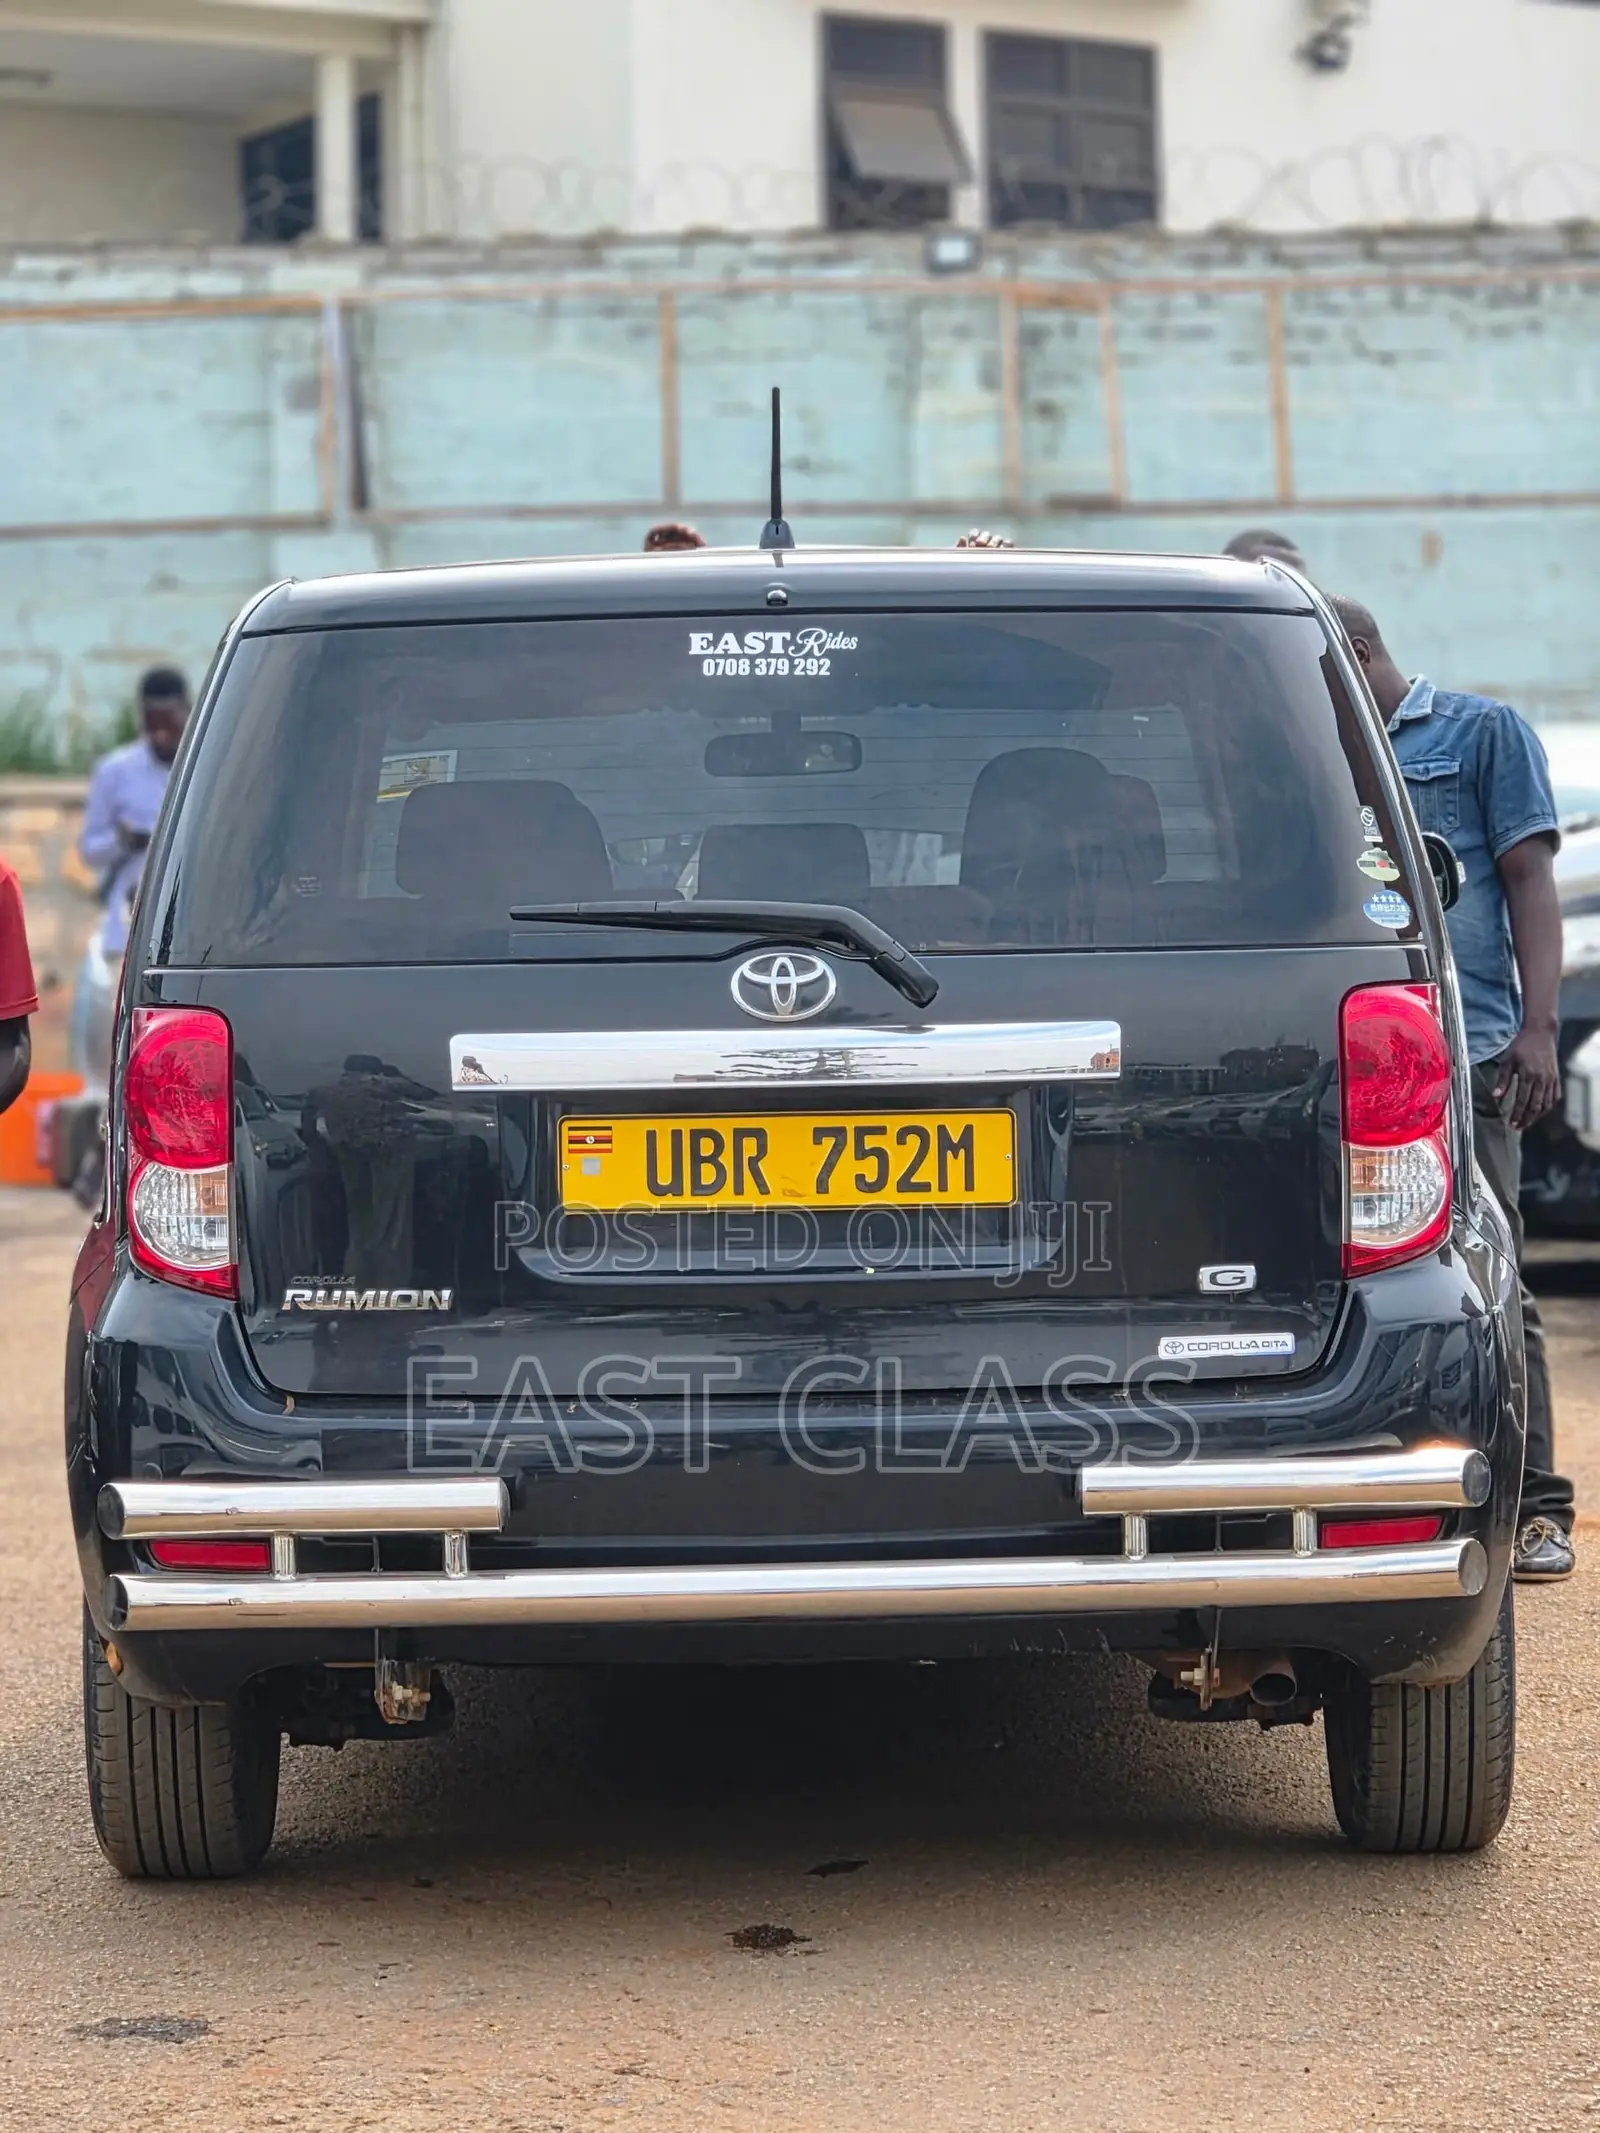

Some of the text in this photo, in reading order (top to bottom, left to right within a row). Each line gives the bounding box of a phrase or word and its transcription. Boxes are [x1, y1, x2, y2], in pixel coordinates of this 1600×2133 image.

[688, 628, 859, 657] EAST Rides
[702, 658, 831, 676] 0708 379 292
[646, 1123, 975, 1197] UBR 752M
[290, 1275, 356, 1286] COROLLA
[1208, 1269, 1248, 1287] G
[281, 1289, 453, 1311] RUMION
[1187, 1339, 1260, 1353] COROLLA
